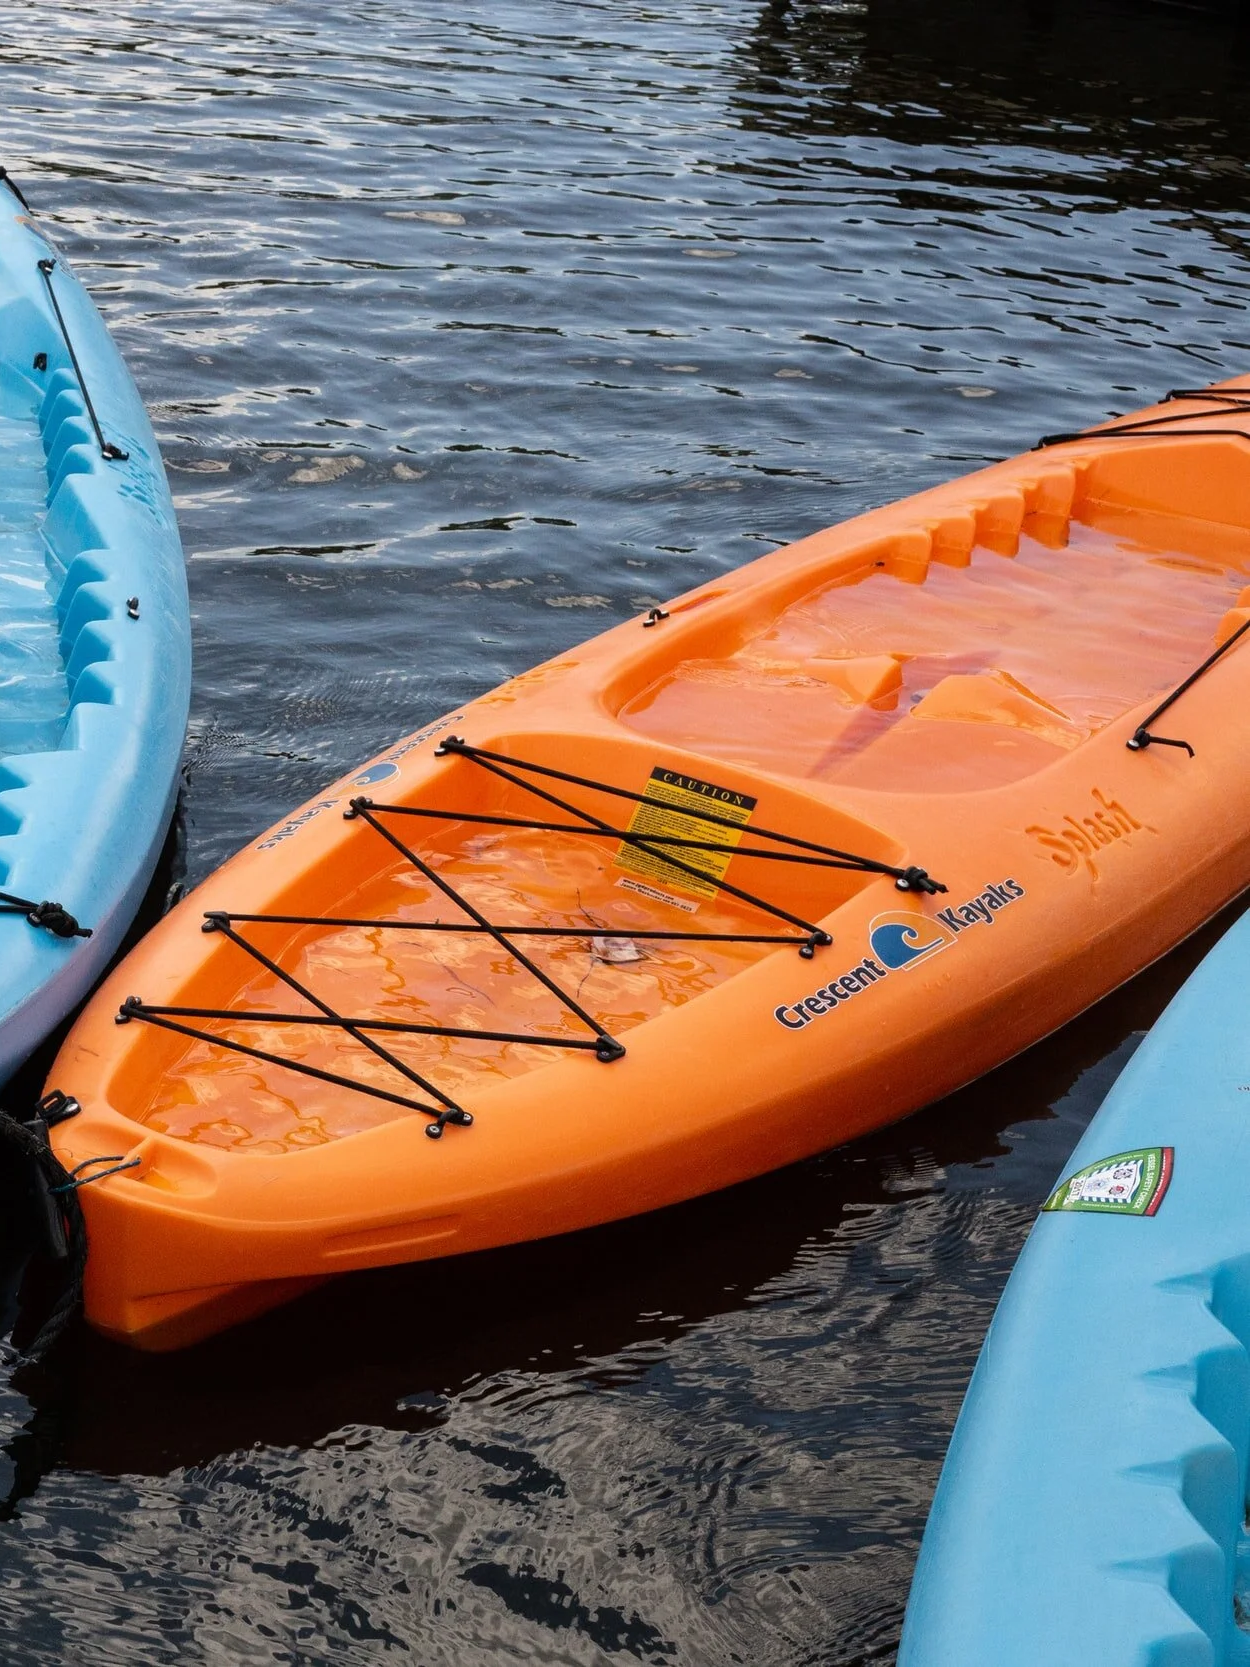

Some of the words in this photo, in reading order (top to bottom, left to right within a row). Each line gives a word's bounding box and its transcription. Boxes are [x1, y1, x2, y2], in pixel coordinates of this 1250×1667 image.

[380, 715, 465, 762] Crescent
[663, 772, 744, 806] CAUTION
[256, 799, 340, 850] Kayaks
[1025, 787, 1144, 883] Splash
[774, 957, 887, 1030] Crescent
[935, 877, 1026, 934] Kayaks
[1132, 1193, 1148, 1210] CHECK
[1142, 1171, 1155, 1194] SAFETY
